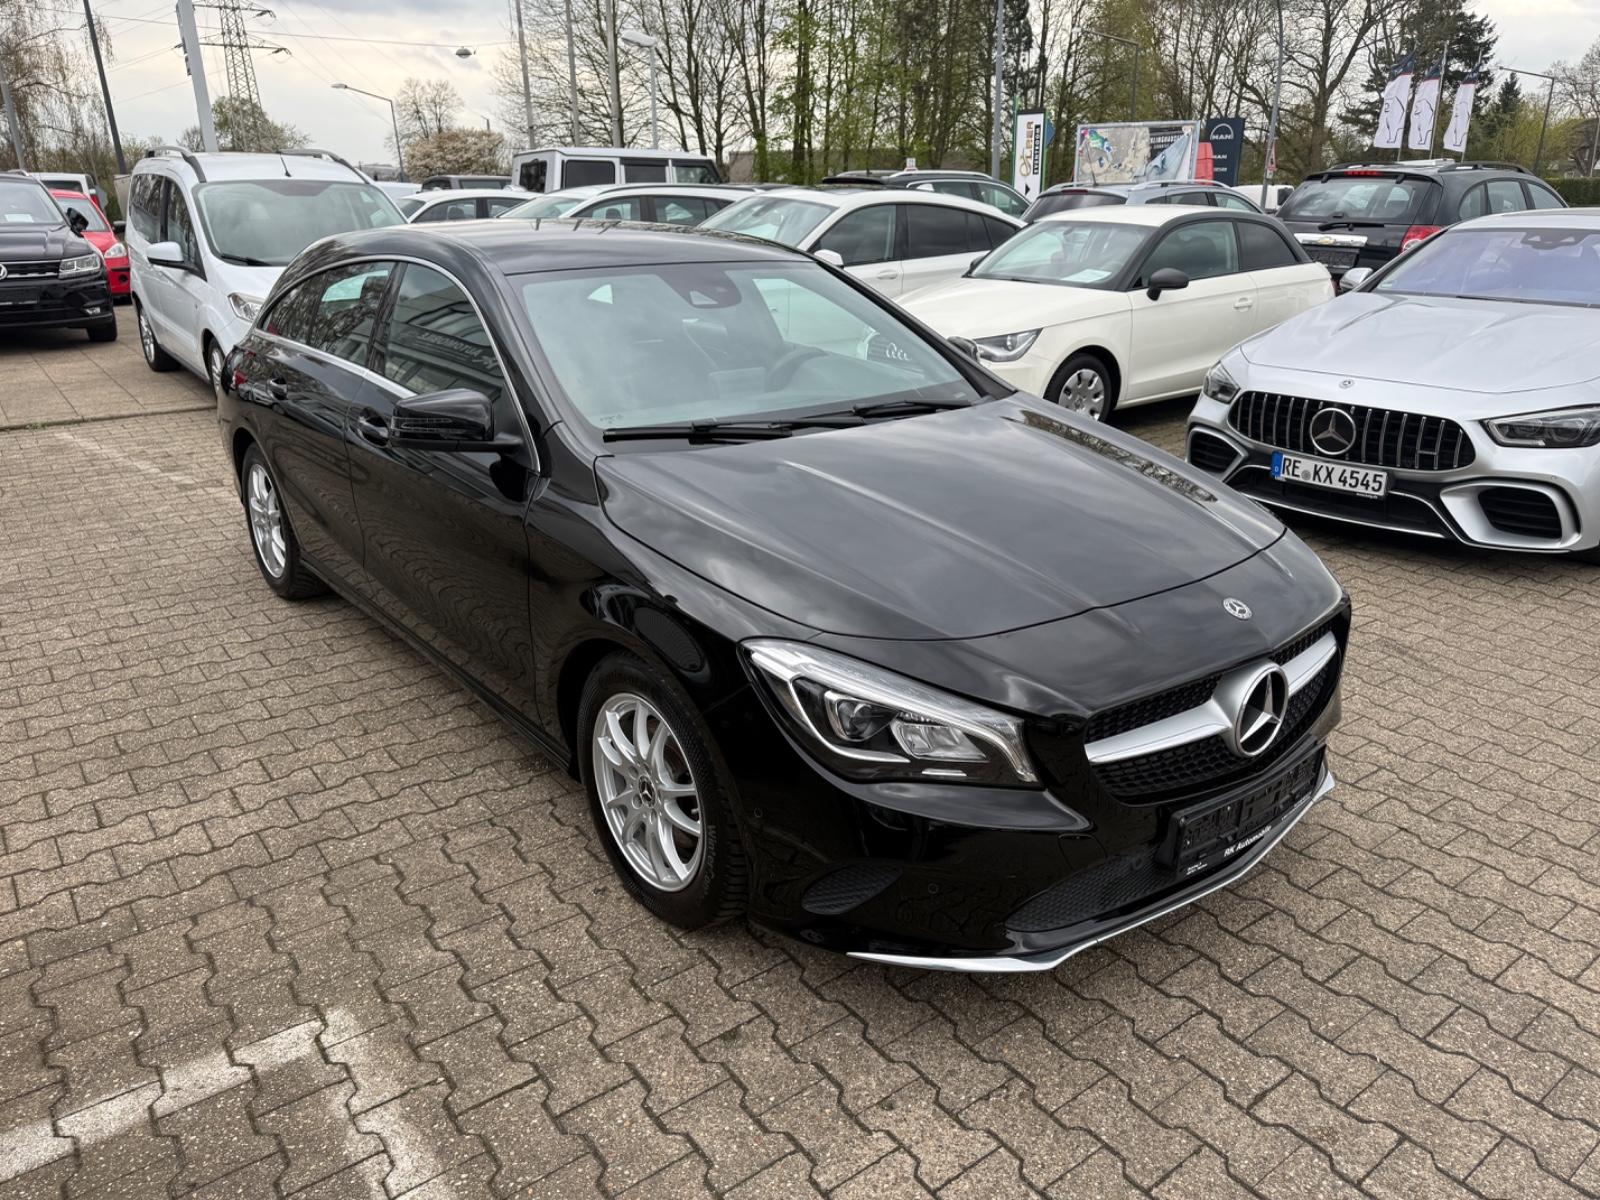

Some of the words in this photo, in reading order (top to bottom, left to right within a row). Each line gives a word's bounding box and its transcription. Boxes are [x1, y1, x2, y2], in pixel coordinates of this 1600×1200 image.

[1282, 458, 1301, 477] RE
[1312, 464, 1335, 485] KX
[1338, 469, 1383, 492] 4545
